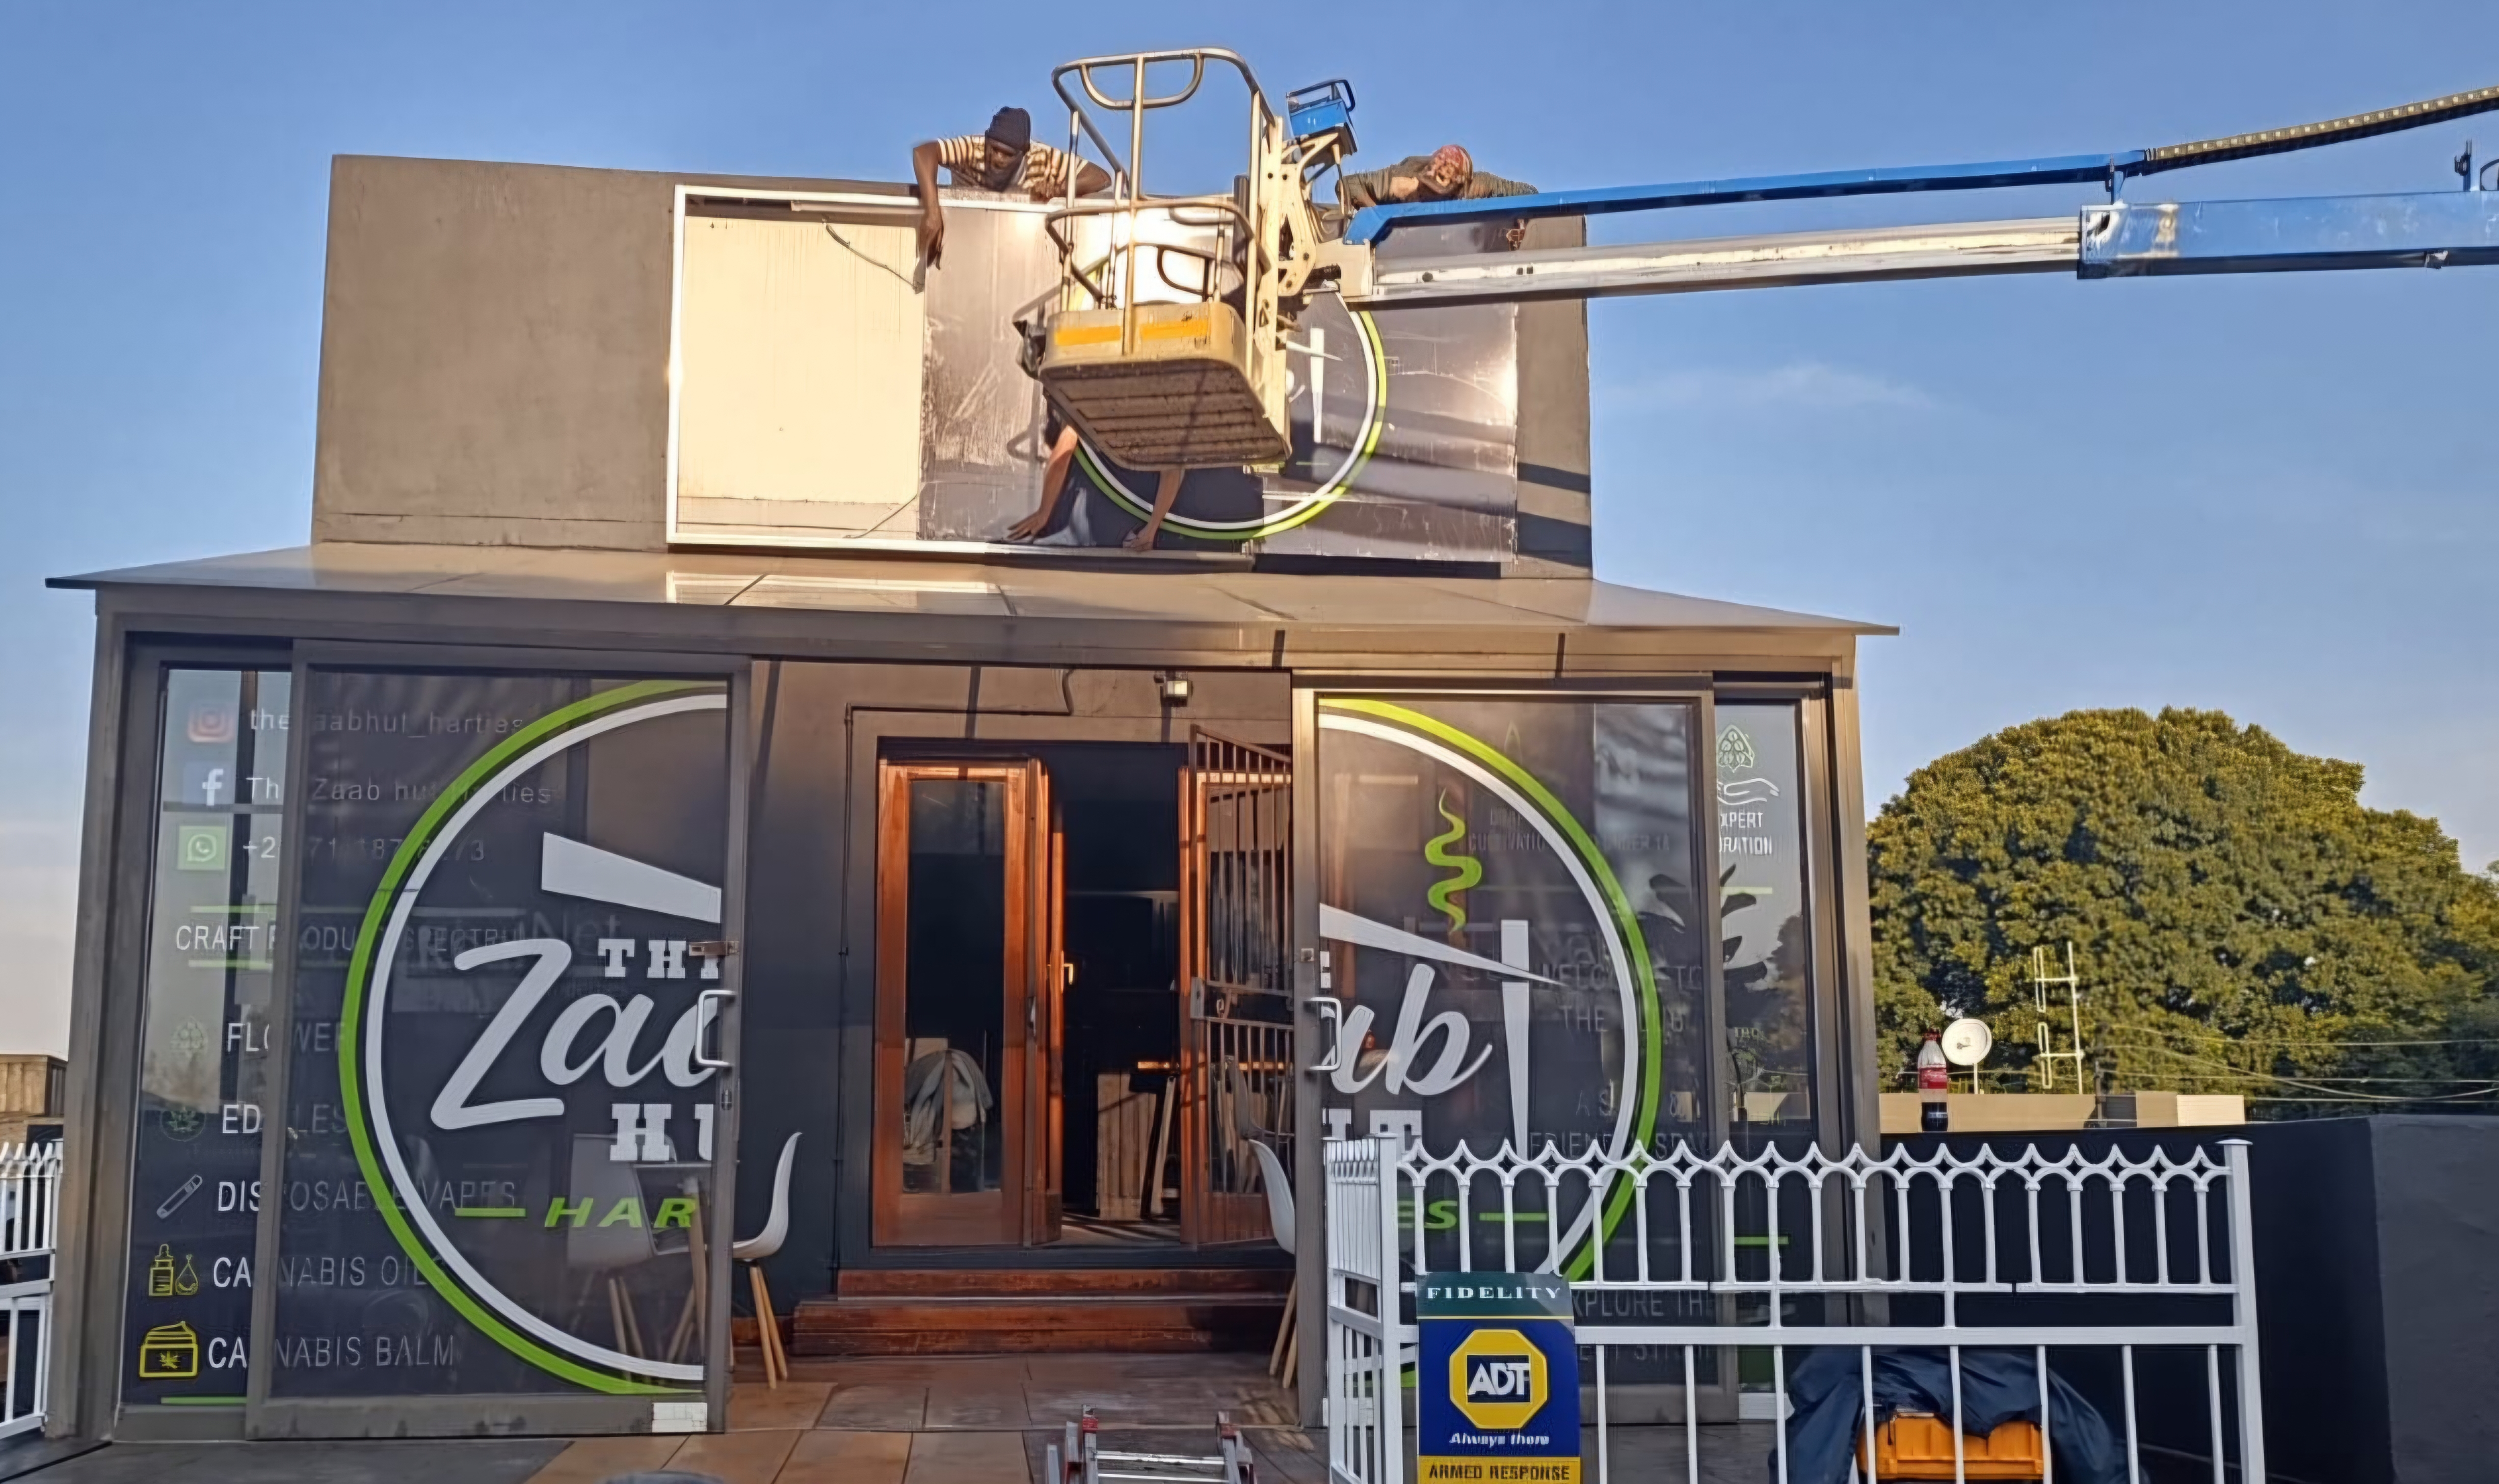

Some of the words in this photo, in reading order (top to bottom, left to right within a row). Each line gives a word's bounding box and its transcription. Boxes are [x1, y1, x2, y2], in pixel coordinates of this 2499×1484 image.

[246, 777, 279, 799] Th
[243, 836, 276, 859] +2
[175, 924, 259, 950] CRAFT
[545, 1198, 697, 1228] HAR
[214, 1255, 365, 1287] CANABIS
[1427, 1287, 1561, 1299] FIDELITY
[1572, 1289, 1664, 1317] XPLORE
[208, 1335, 361, 1368] CANABIS
[376, 1335, 454, 1366] BALM
[1468, 1362, 1530, 1395] ADT
[1449, 1433, 1506, 1448] Always
[1429, 1464, 1482, 1478] ARMED
[1490, 1465, 1570, 1480] RESPONSE
